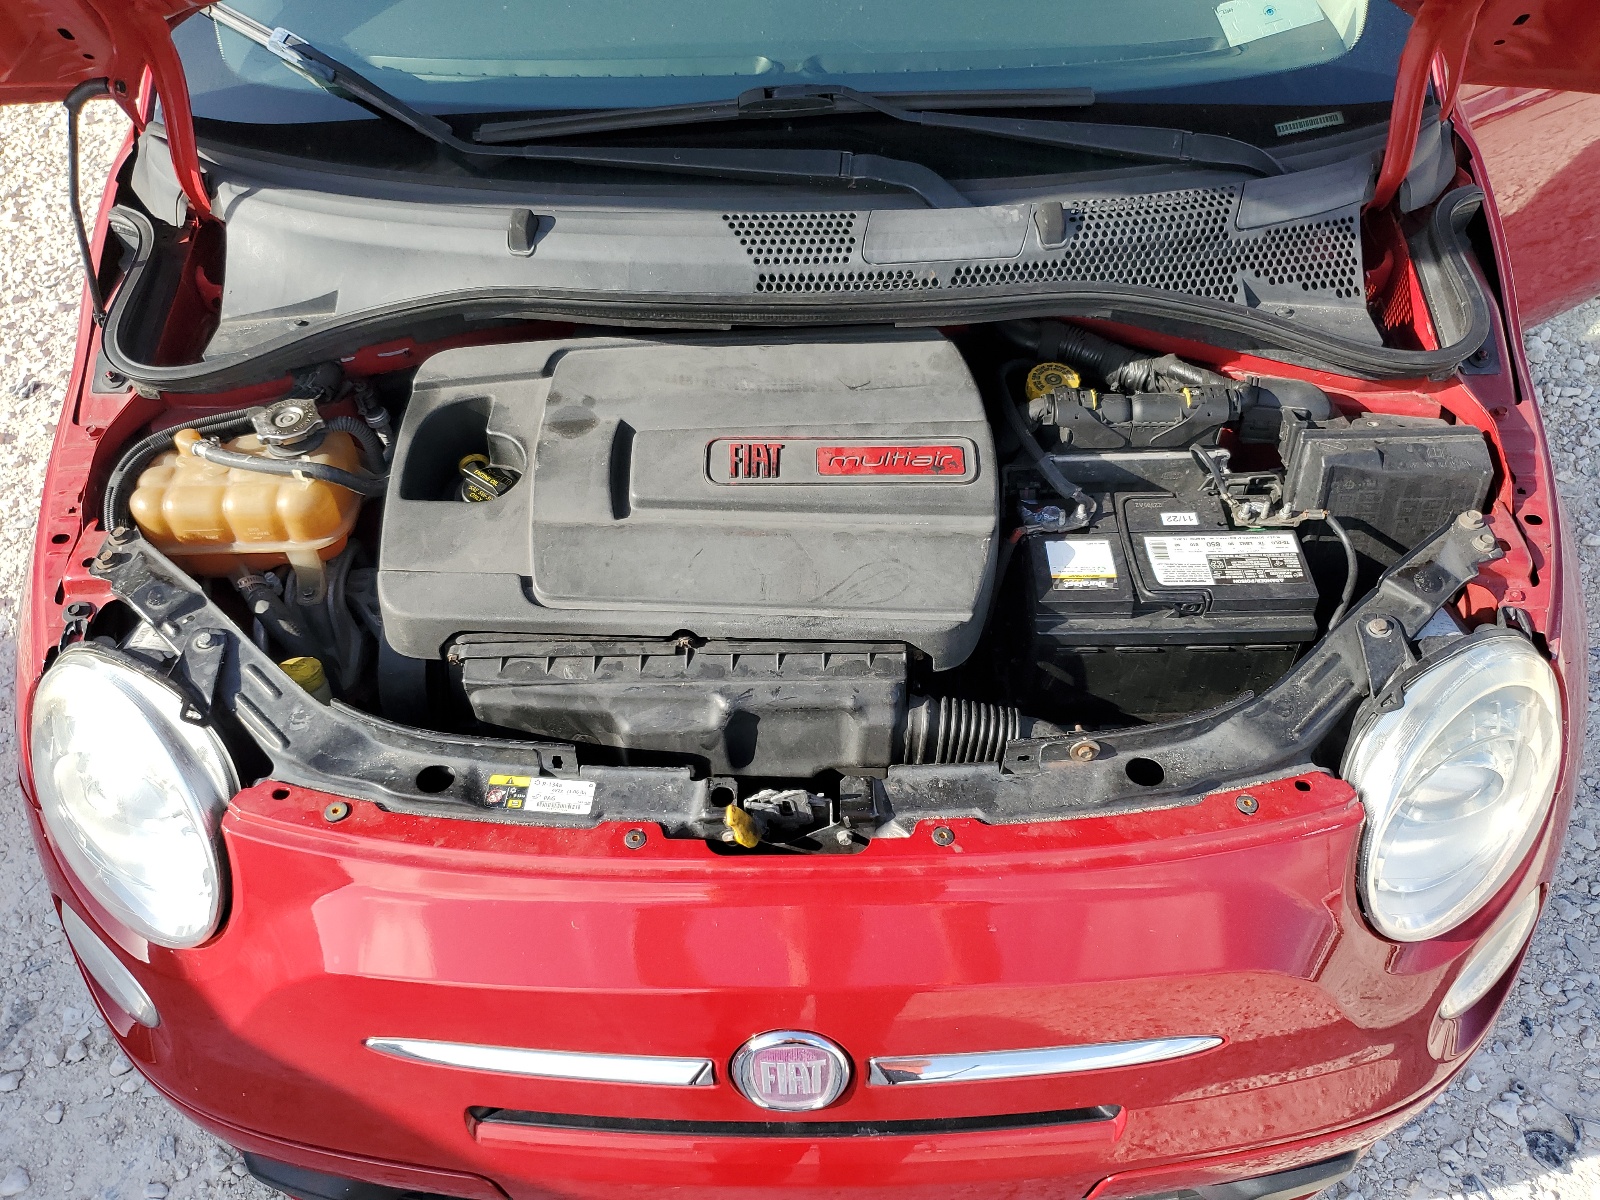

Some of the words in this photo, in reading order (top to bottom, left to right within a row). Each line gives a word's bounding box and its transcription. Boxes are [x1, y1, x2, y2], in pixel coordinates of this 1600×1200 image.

[729, 443, 785, 479] FIAT
[828, 451, 953, 468] multiair
[474, 470, 491, 481] ENGINE
[490, 479, 499, 487] OIL
[1167, 515, 1194, 523] 11/22
[1063, 579, 1108, 588] Duralast
[760, 1059, 827, 1095] FIAT
